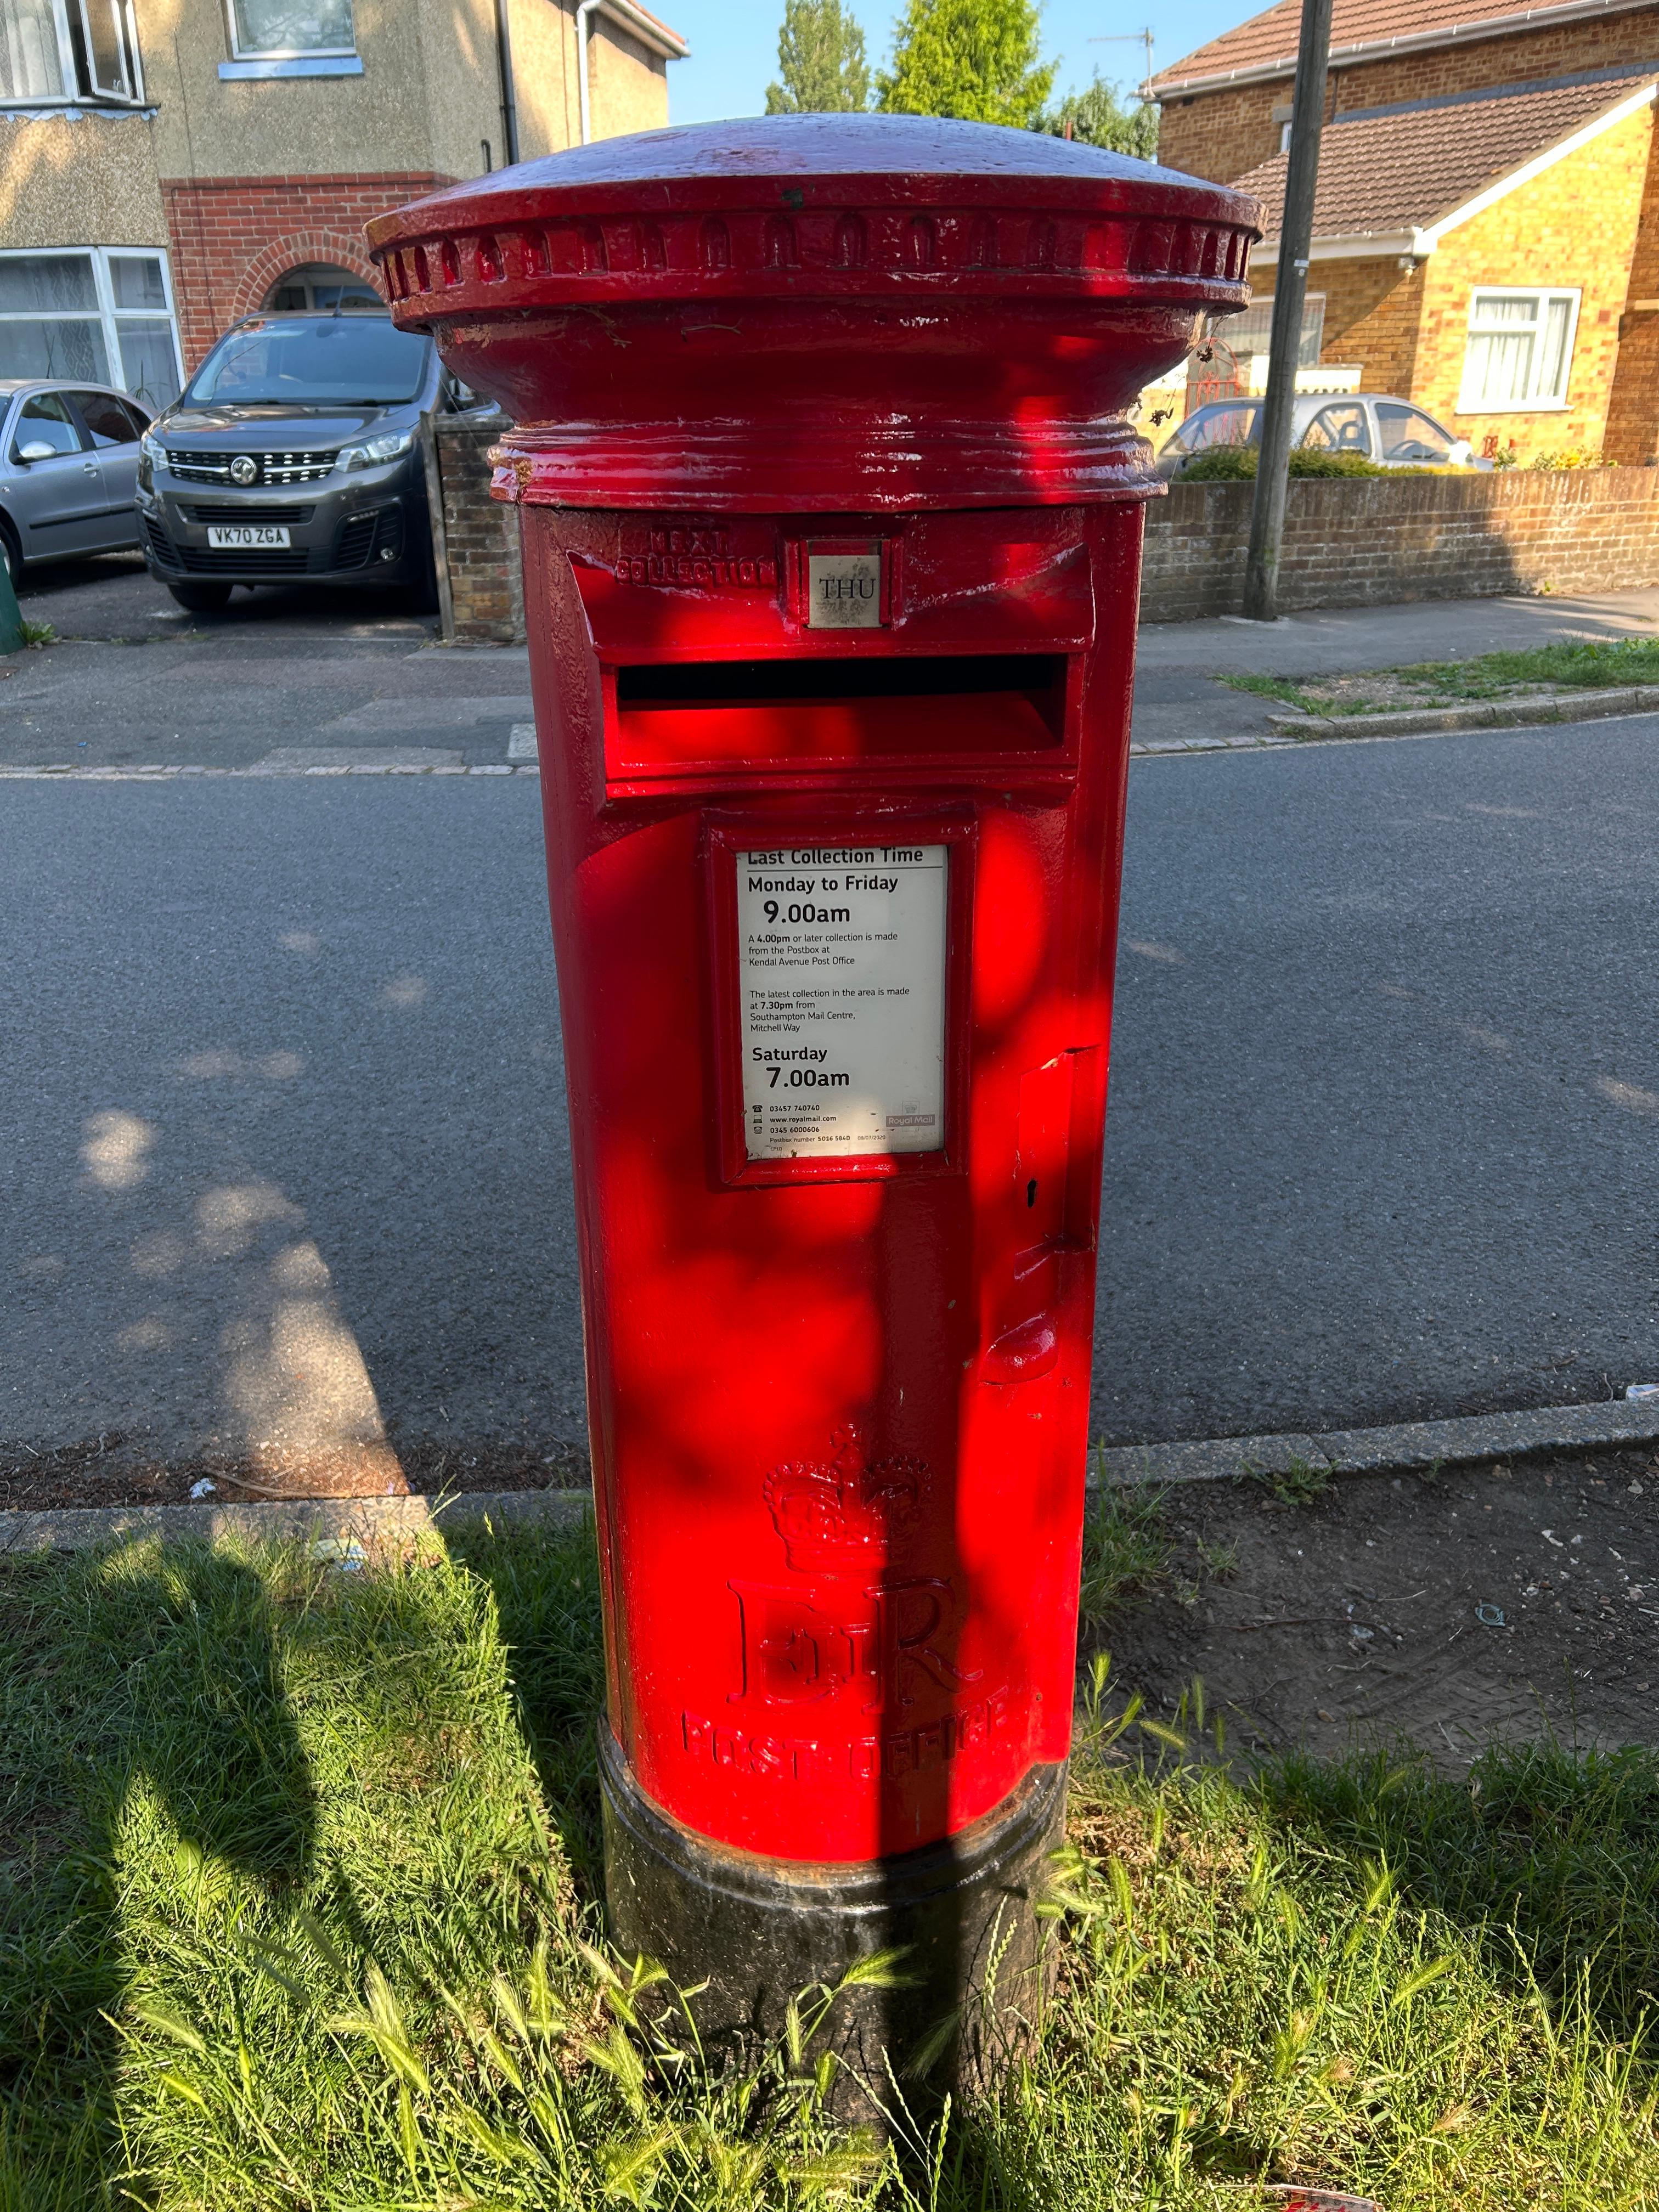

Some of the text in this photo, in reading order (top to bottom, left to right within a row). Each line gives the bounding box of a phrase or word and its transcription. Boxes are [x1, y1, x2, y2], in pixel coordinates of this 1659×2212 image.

[215, 528, 284, 544] VK70 ZGA
[651, 525, 729, 554] NEXT
[616, 555, 778, 588] COLLECTION
[819, 578, 876, 599] THU
[747, 847, 924, 865] Last Collection Time
[748, 876, 899, 894] Monday to Friday
[763, 900, 850, 924] 9.00am
[748, 934, 755, 943] A
[757, 934, 791, 945] 4.00pm
[804, 934, 823, 943] later
[825, 933, 864, 943] collection
[866, 933, 872, 941] is
[874, 933, 898, 941] made
[749, 945, 830, 955] from the Postbox at
[749, 956, 855, 967] Kendal Avenue Post Office
[750, 990, 766, 998] The
[768, 989, 791, 998] latest
[792, 989, 830, 998] collection
[832, 989, 839, 997] in
[878, 988, 885, 996] is
[750, 1001, 816, 1012] at 7.30pm from
[750, 1012, 856, 1023] Southampton Mail Centre,
[751, 1024, 800, 1032] Mitchell Way
[752, 1047, 828, 1063] Saturday
[766, 1067, 850, 1088] 7.00am
[769, 1115, 837, 1124] www.royalmail.com
[888, 1116, 933, 1126] Royal Mail
[681, 1708, 819, 1781] POST
